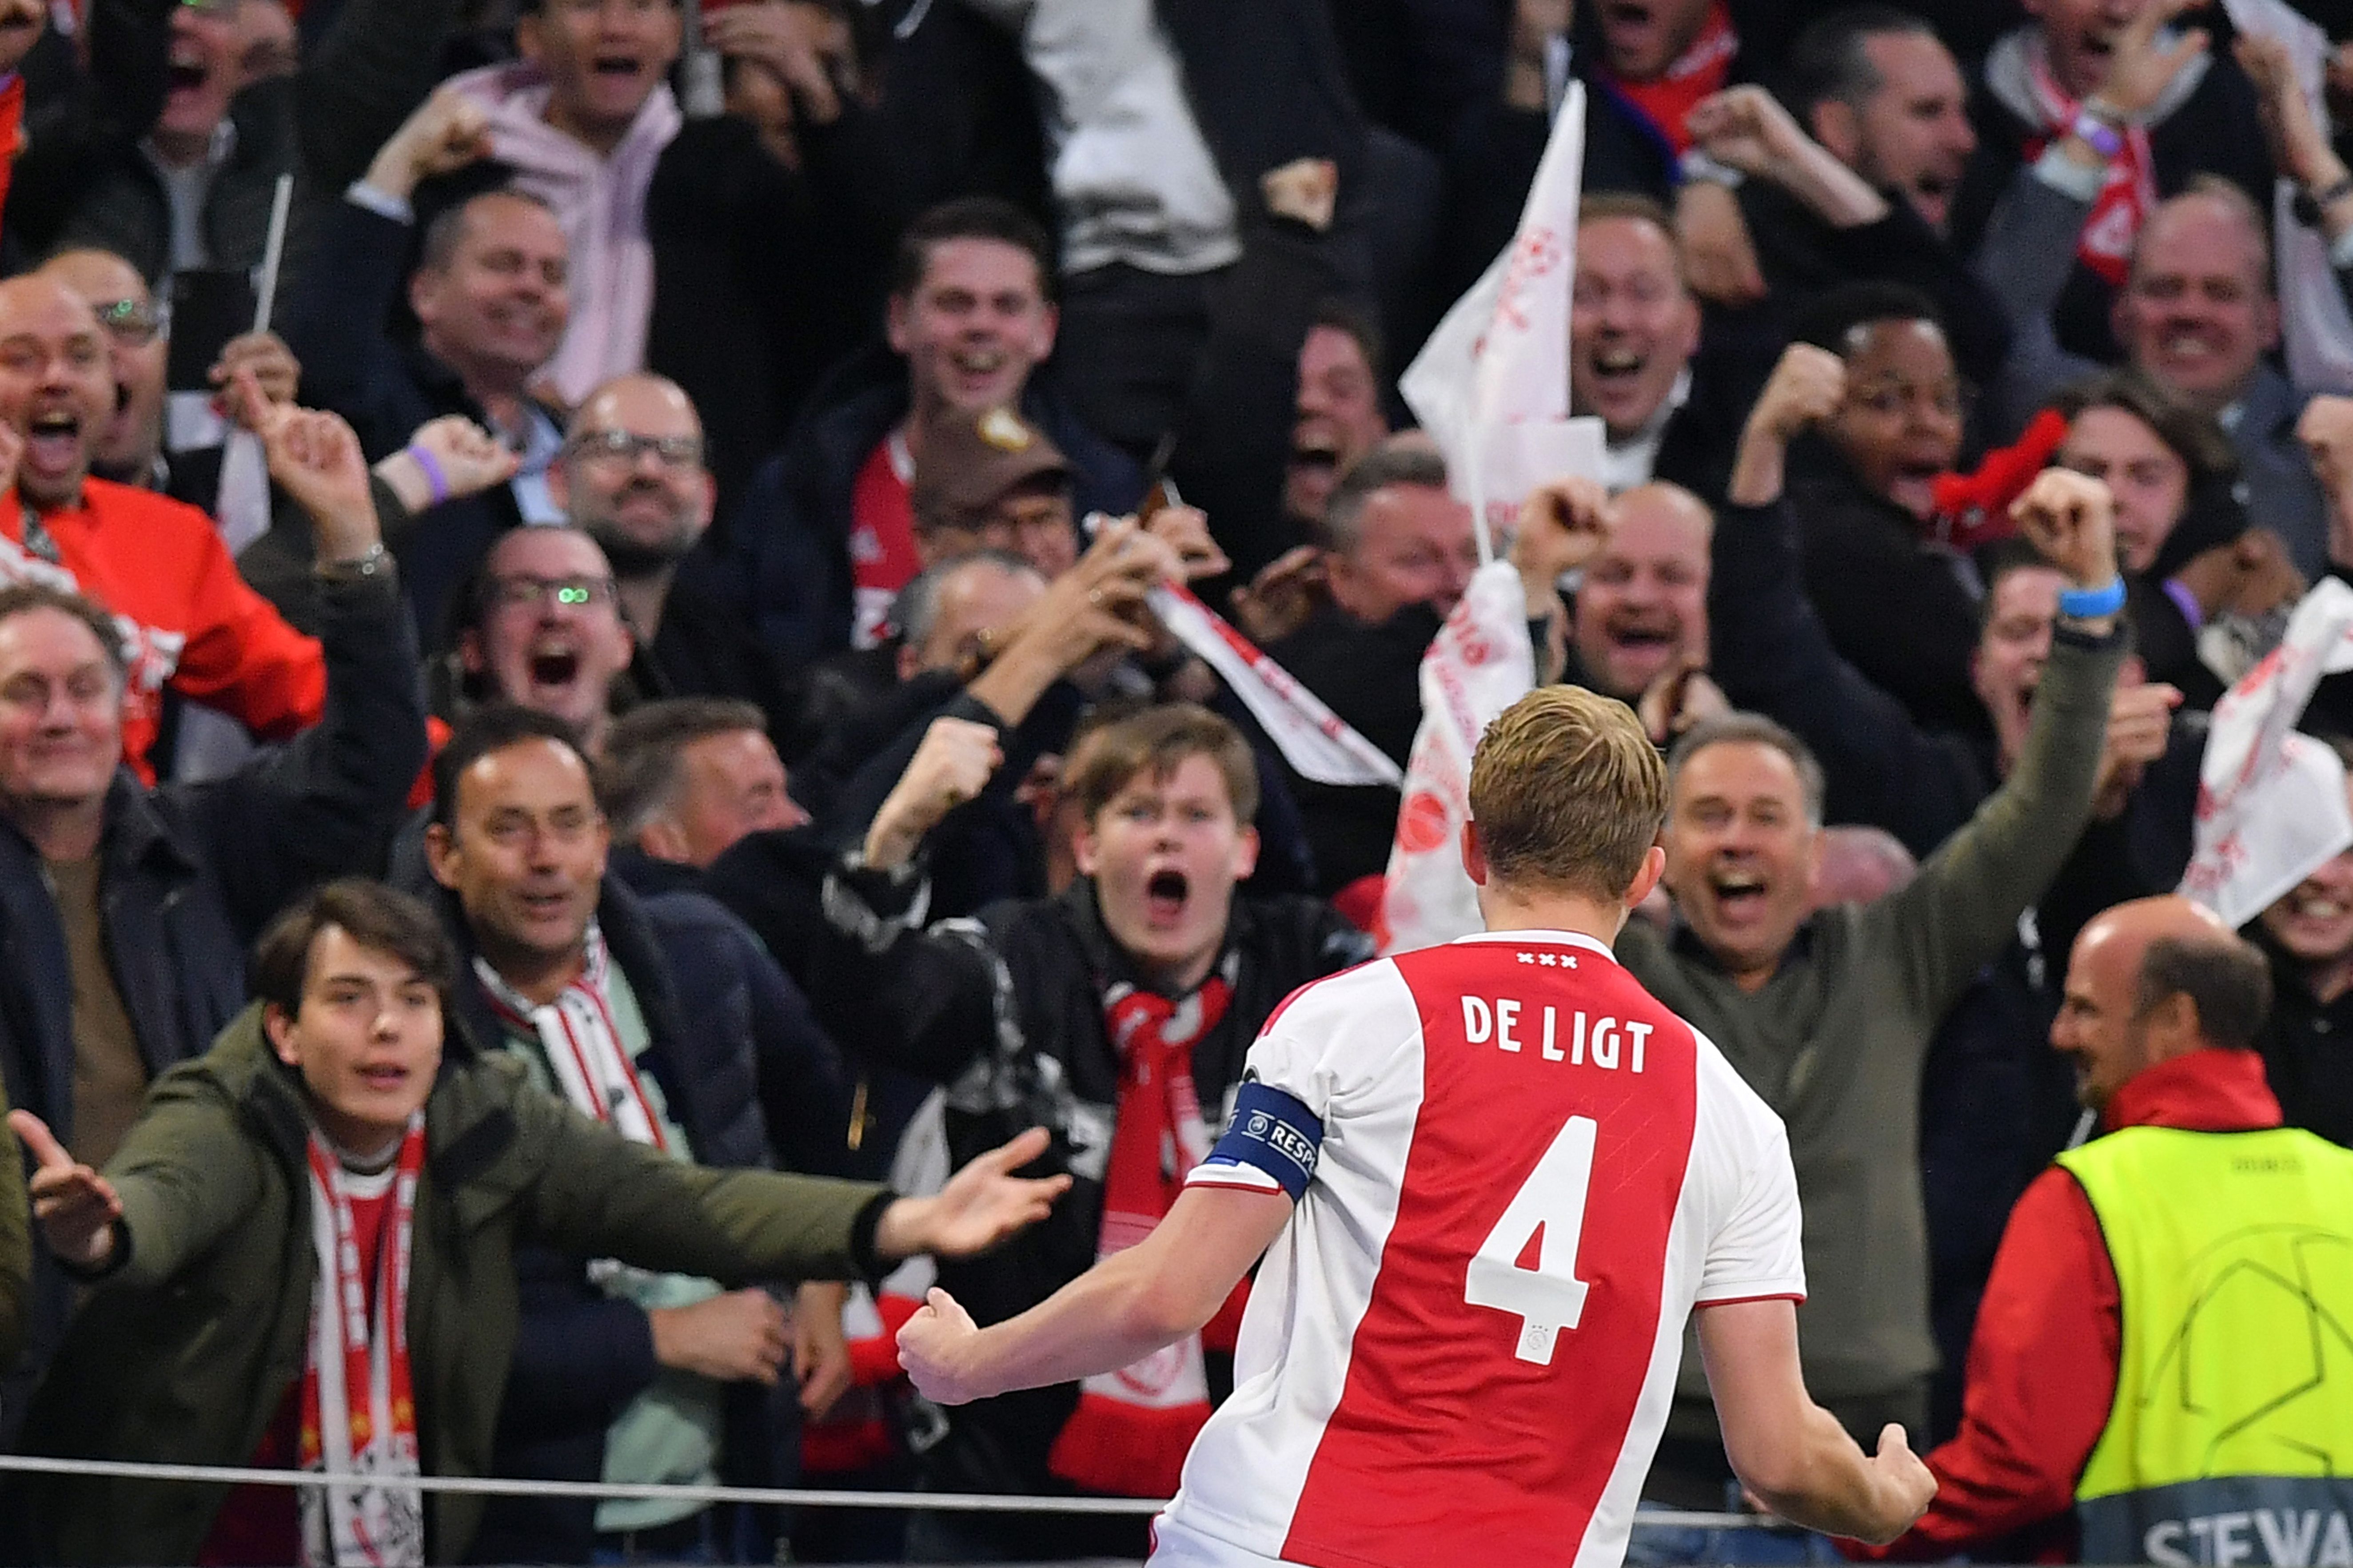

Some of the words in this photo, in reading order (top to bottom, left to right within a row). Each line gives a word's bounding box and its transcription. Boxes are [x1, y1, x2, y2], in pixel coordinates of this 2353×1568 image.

[1461, 995, 1522, 1052] DE
[1542, 1006, 1654, 1073] LIGT
[1464, 1115, 1598, 1366] 4
